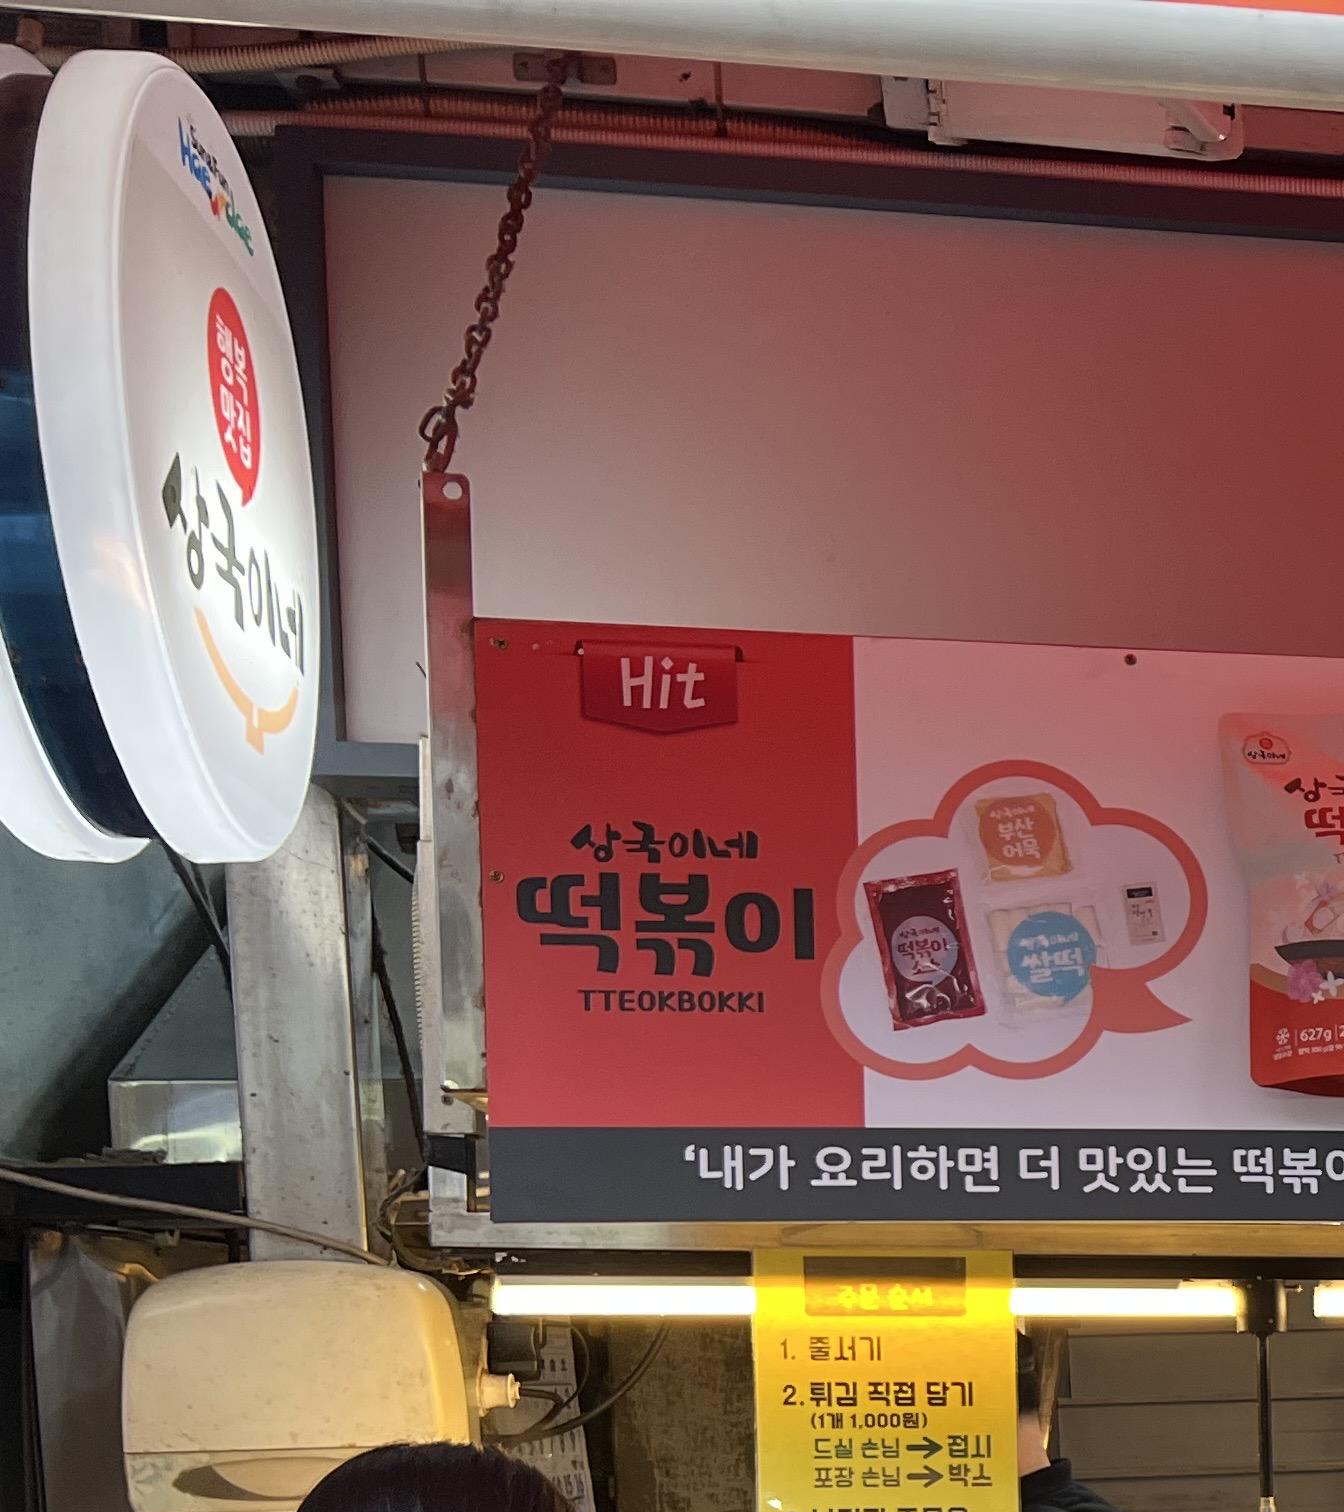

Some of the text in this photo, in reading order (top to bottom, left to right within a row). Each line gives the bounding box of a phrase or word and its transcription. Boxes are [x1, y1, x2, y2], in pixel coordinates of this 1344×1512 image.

[162, 452, 305, 678] 상국이네
[619, 655, 706, 710] Hit
[998, 817, 1034, 839] 부산
[570, 820, 759, 863] 상국이네
[1002, 838, 1041, 859] 어묵
[516, 872, 815, 977] 떡볶이
[1022, 947, 1085, 984] 쌀떡
[576, 989, 766, 1014] TTEOKBOKKI
[1299, 1026, 1332, 1043] 627g
[810, 1144, 1001, 1194] 요리하면
[1018, 1144, 1061, 1193] 더
[1080, 1145, 1218, 1195] 맛있는
[780, 1336, 882, 1361] 1. 줄서기
[810, 1381, 974, 1407] 튀김 직접 담기
[811, 1412, 928, 1430] (1개 1,000원)
[814, 1434, 993, 1460] 드실 손님 접시
[814, 1463, 993, 1489] 포장 손님 박스
